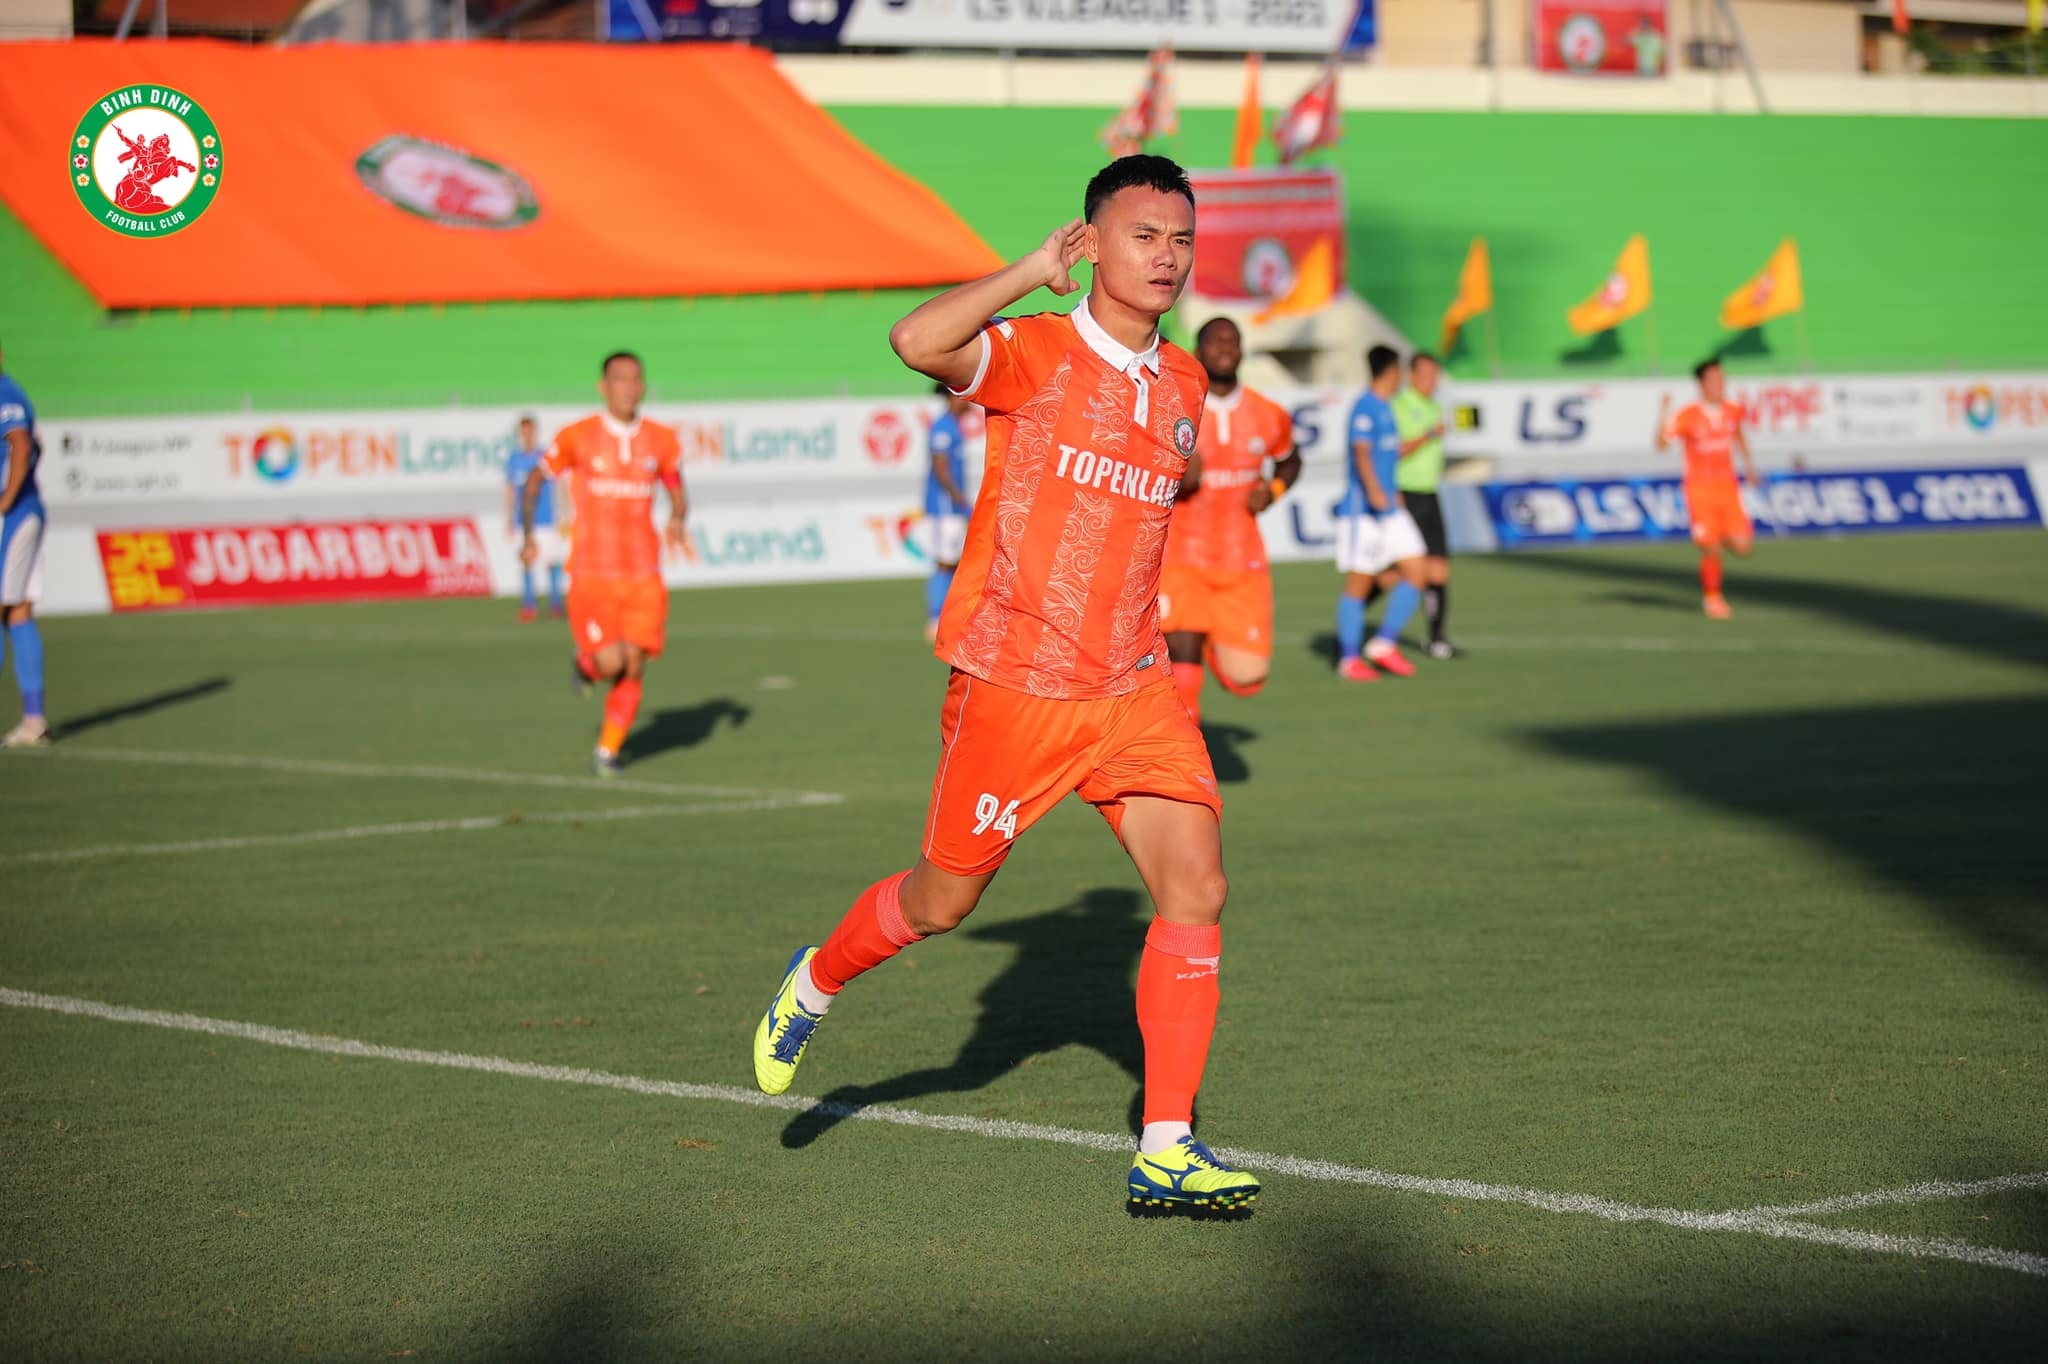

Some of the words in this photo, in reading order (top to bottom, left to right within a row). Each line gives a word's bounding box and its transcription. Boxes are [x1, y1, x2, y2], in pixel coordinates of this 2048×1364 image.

[1517, 396, 1588, 442] LS
[1055, 443, 1182, 510] TOPENLAN
[1912, 473, 2032, 522] 2021
[187, 522, 488, 586] JOGARBOLA
[971, 792, 1021, 840] 94
